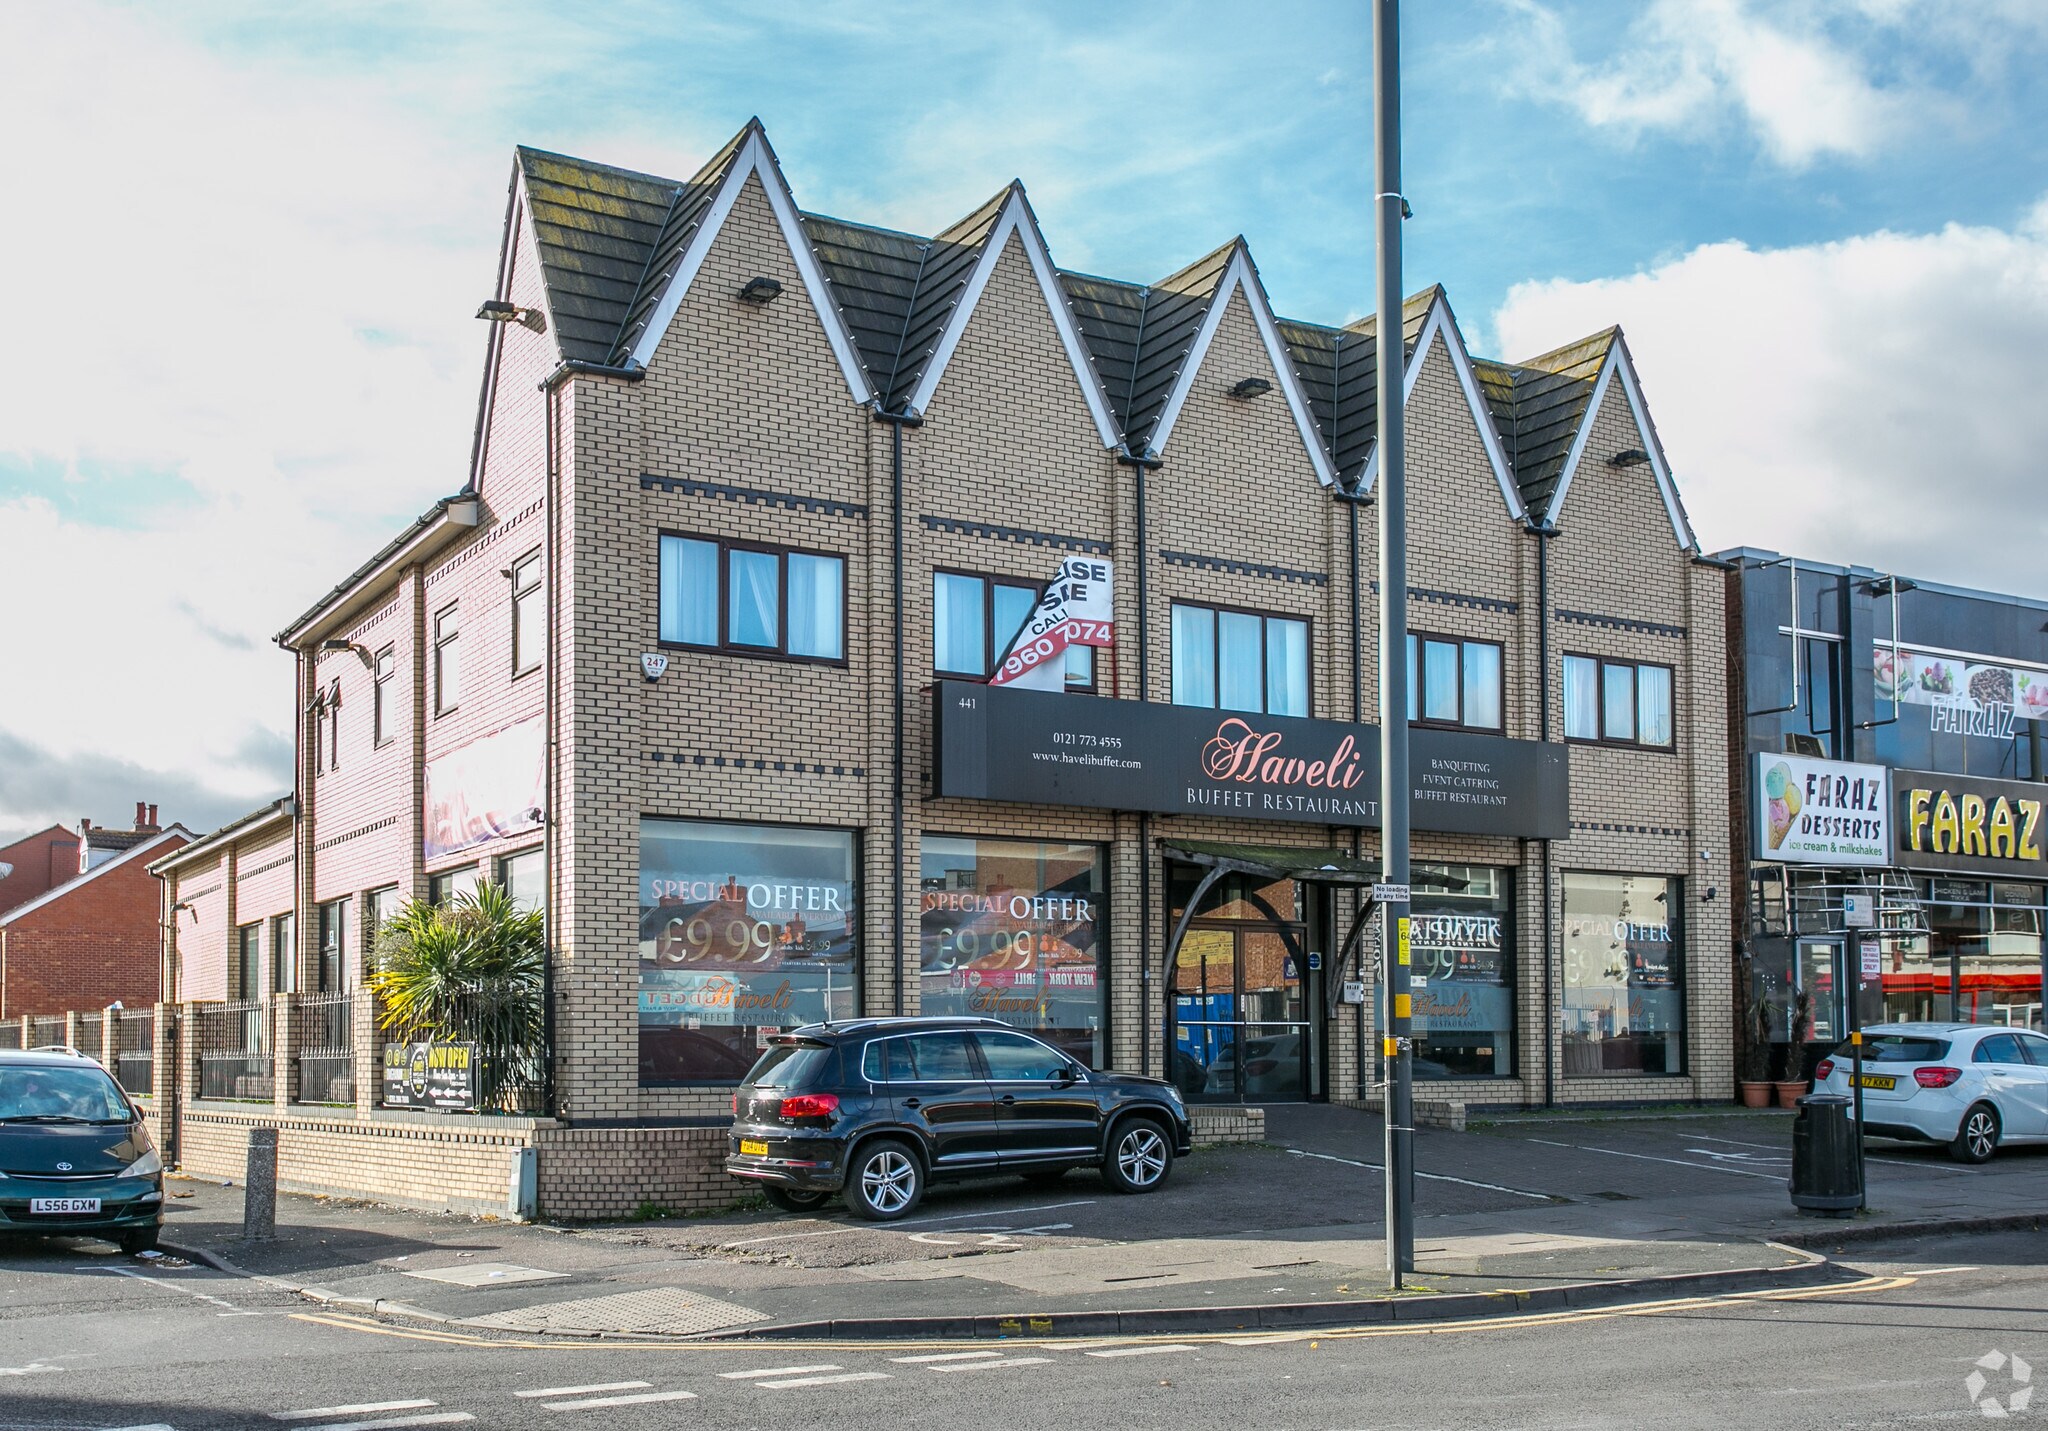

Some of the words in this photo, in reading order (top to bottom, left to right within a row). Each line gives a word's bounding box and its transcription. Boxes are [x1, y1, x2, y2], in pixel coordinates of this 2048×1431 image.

[647, 657, 664, 667] 247
[958, 697, 976, 709] 441
[1931, 694, 2017, 740] FARAZ
[1053, 732, 1076, 745] 0121
[1079, 734, 1097, 747] 773
[1099, 737, 1122, 748] 4555
[1032, 752, 1142, 769] www.havelibuffet.com
[1202, 717, 1364, 789] Haveli
[1431, 758, 1490, 773] BANQUETING
[1423, 774, 1452, 786] EVENT
[1454, 776, 1499, 790] CATERING
[1805, 773, 1880, 811] FARAZ
[1187, 787, 1254, 808] BUFFET
[1264, 793, 1378, 816] RESTAURANT
[1414, 789, 1448, 801] BUFFET
[1449, 792, 1507, 806] RESTAURANT
[1801, 813, 1881, 840] DESSERTS
[1910, 788, 2041, 861] FARAZ
[1789, 838, 1801, 850] ice
[1803, 842, 1828, 852] cream
[1830, 841, 1837, 853] &
[1839, 842, 1882, 856] milkshakes
[652, 879, 743, 902] SPECIAL
[748, 883, 843, 912] OFFER
[926, 892, 1006, 913] SPECIAL
[1009, 895, 1094, 922] OFFER
[1847, 899, 1854, 910] P
[659, 917, 775, 964] £9.99
[1560, 920, 1612, 937] SPECIAL
[1614, 921, 1673, 943] OFFER
[937, 927, 1032, 971] £9.99
[700, 975, 797, 1010] Haveli
[967, 983, 1056, 1013] Haveli
[688, 1012, 728, 1022] BUFFET
[428, 1045, 447, 1068] NOW
[447, 1046, 469, 1069] OPEN
[36, 1200, 69, 1211] LS56
[72, 1200, 96, 1211] GXM
